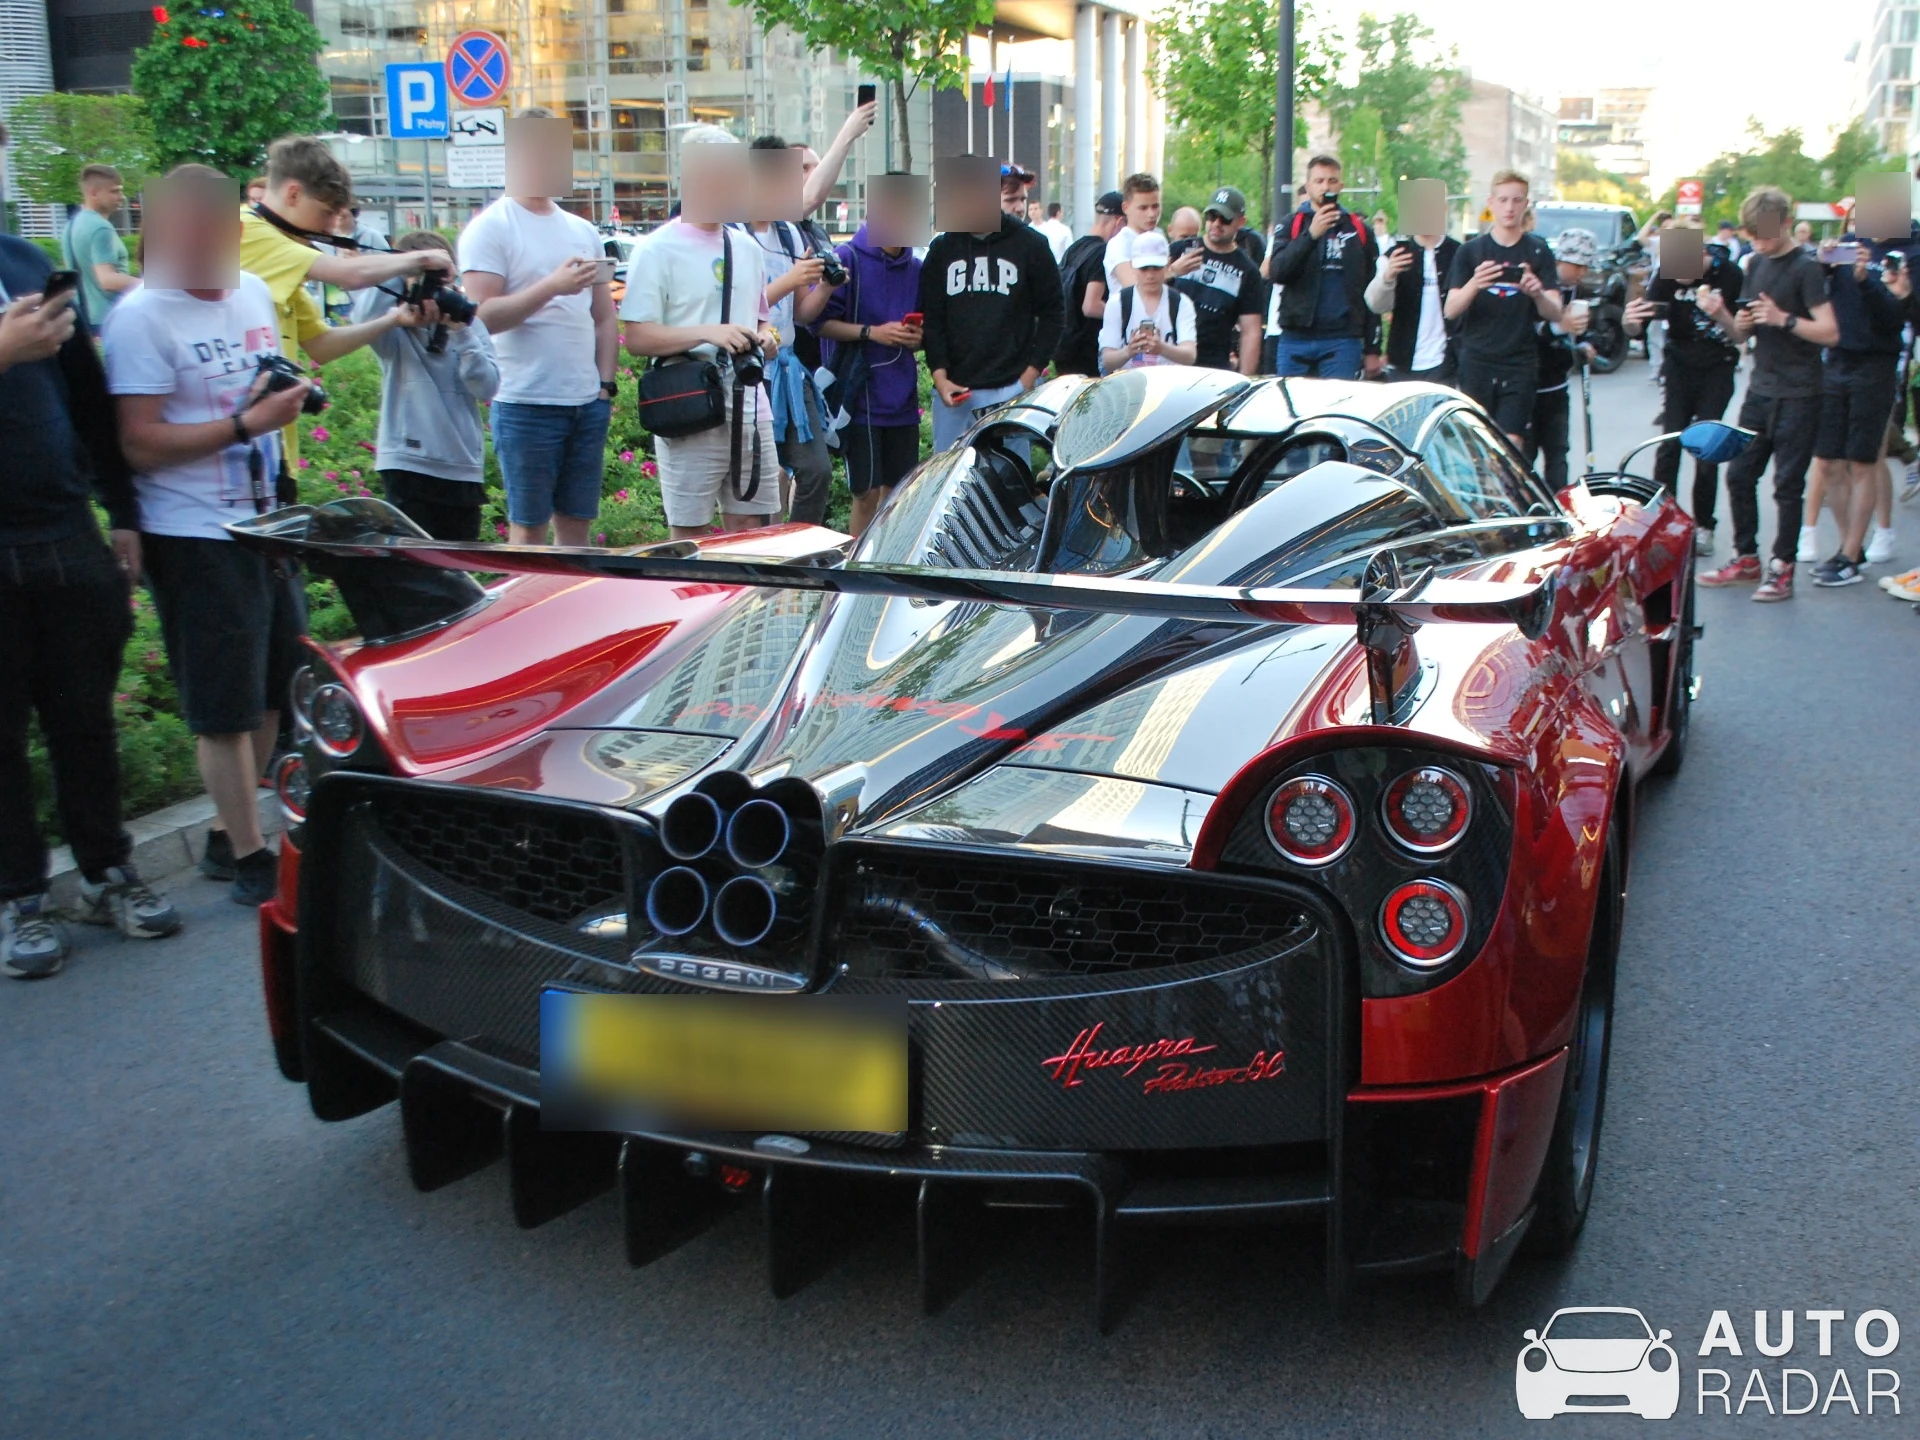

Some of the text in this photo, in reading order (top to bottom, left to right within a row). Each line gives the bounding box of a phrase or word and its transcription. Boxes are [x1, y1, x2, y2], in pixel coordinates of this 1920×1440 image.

[399, 70, 436, 130] P
[658, 958, 775, 988] PAGANI
[1041, 1021, 1218, 1089] Huayra
